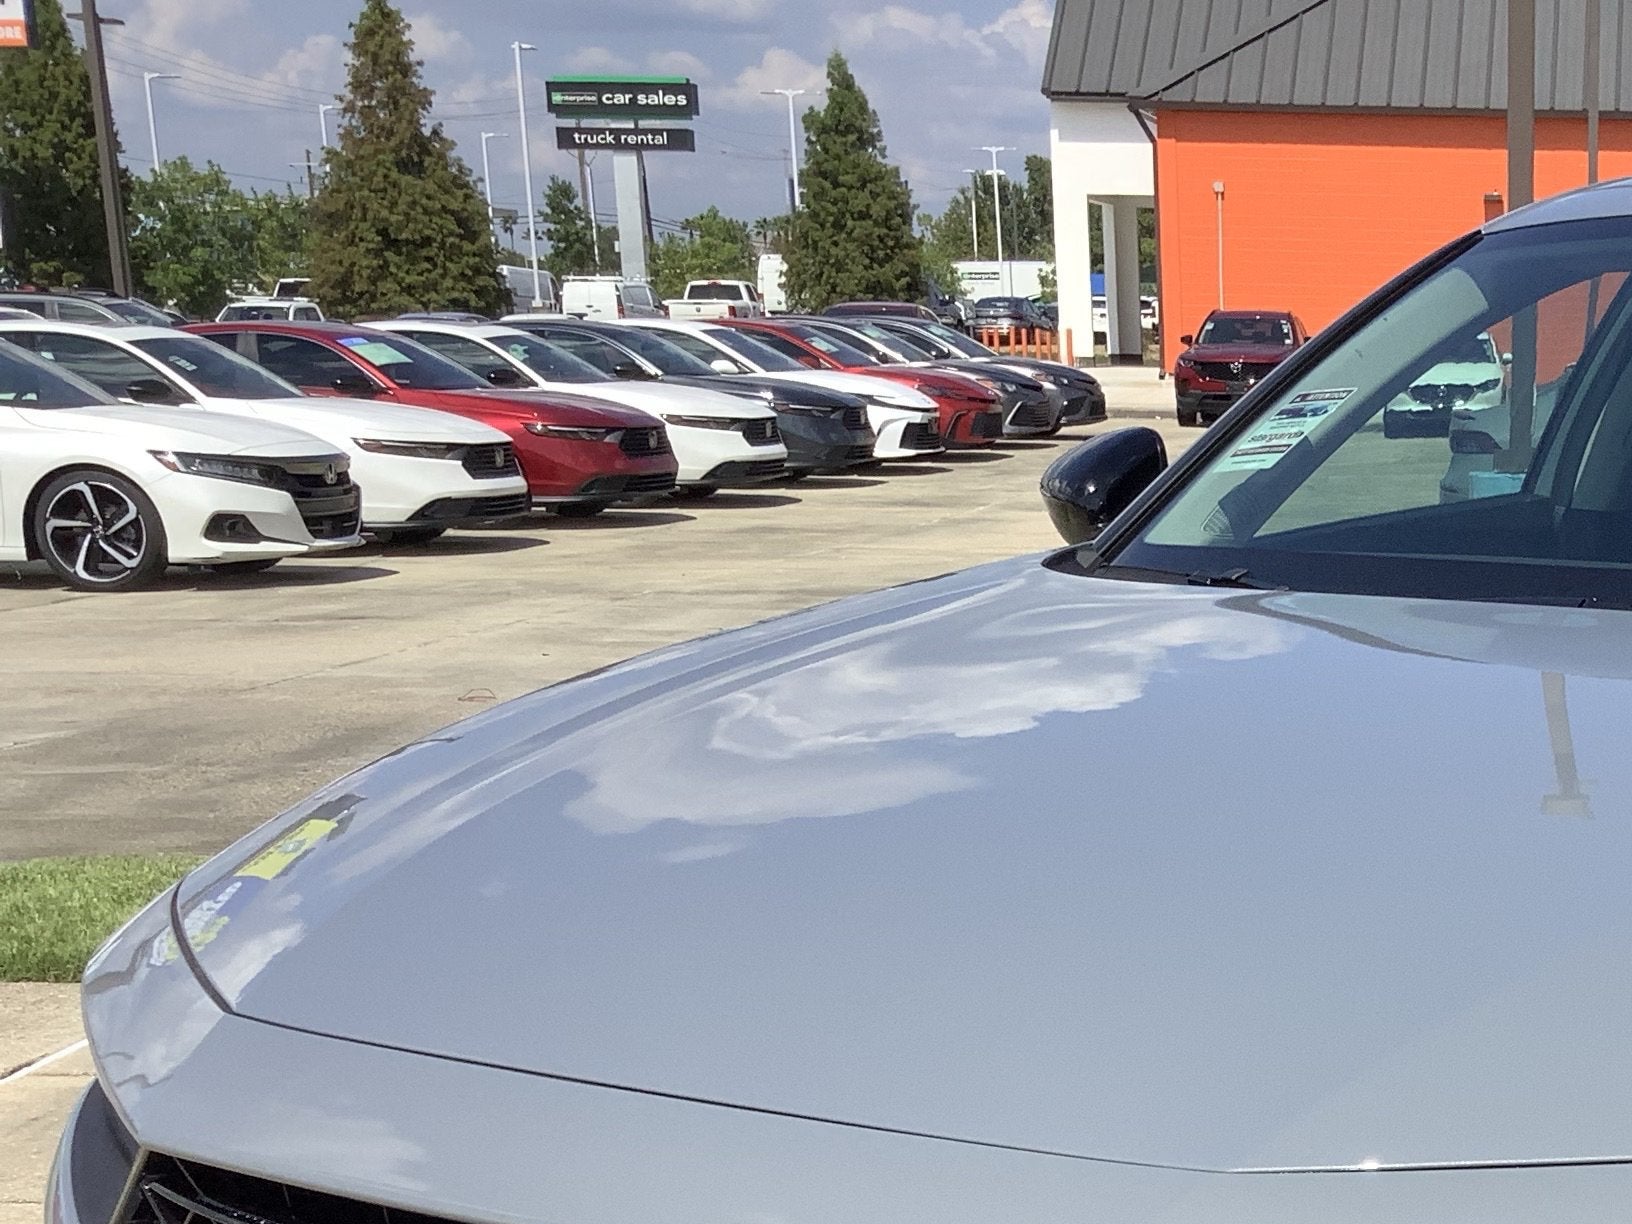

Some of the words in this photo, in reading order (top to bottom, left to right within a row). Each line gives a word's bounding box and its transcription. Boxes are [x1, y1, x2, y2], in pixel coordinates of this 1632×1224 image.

[601, 92, 633, 105] car
[637, 89, 688, 106] sales
[573, 131, 615, 145] truck
[620, 131, 668, 145] rental
